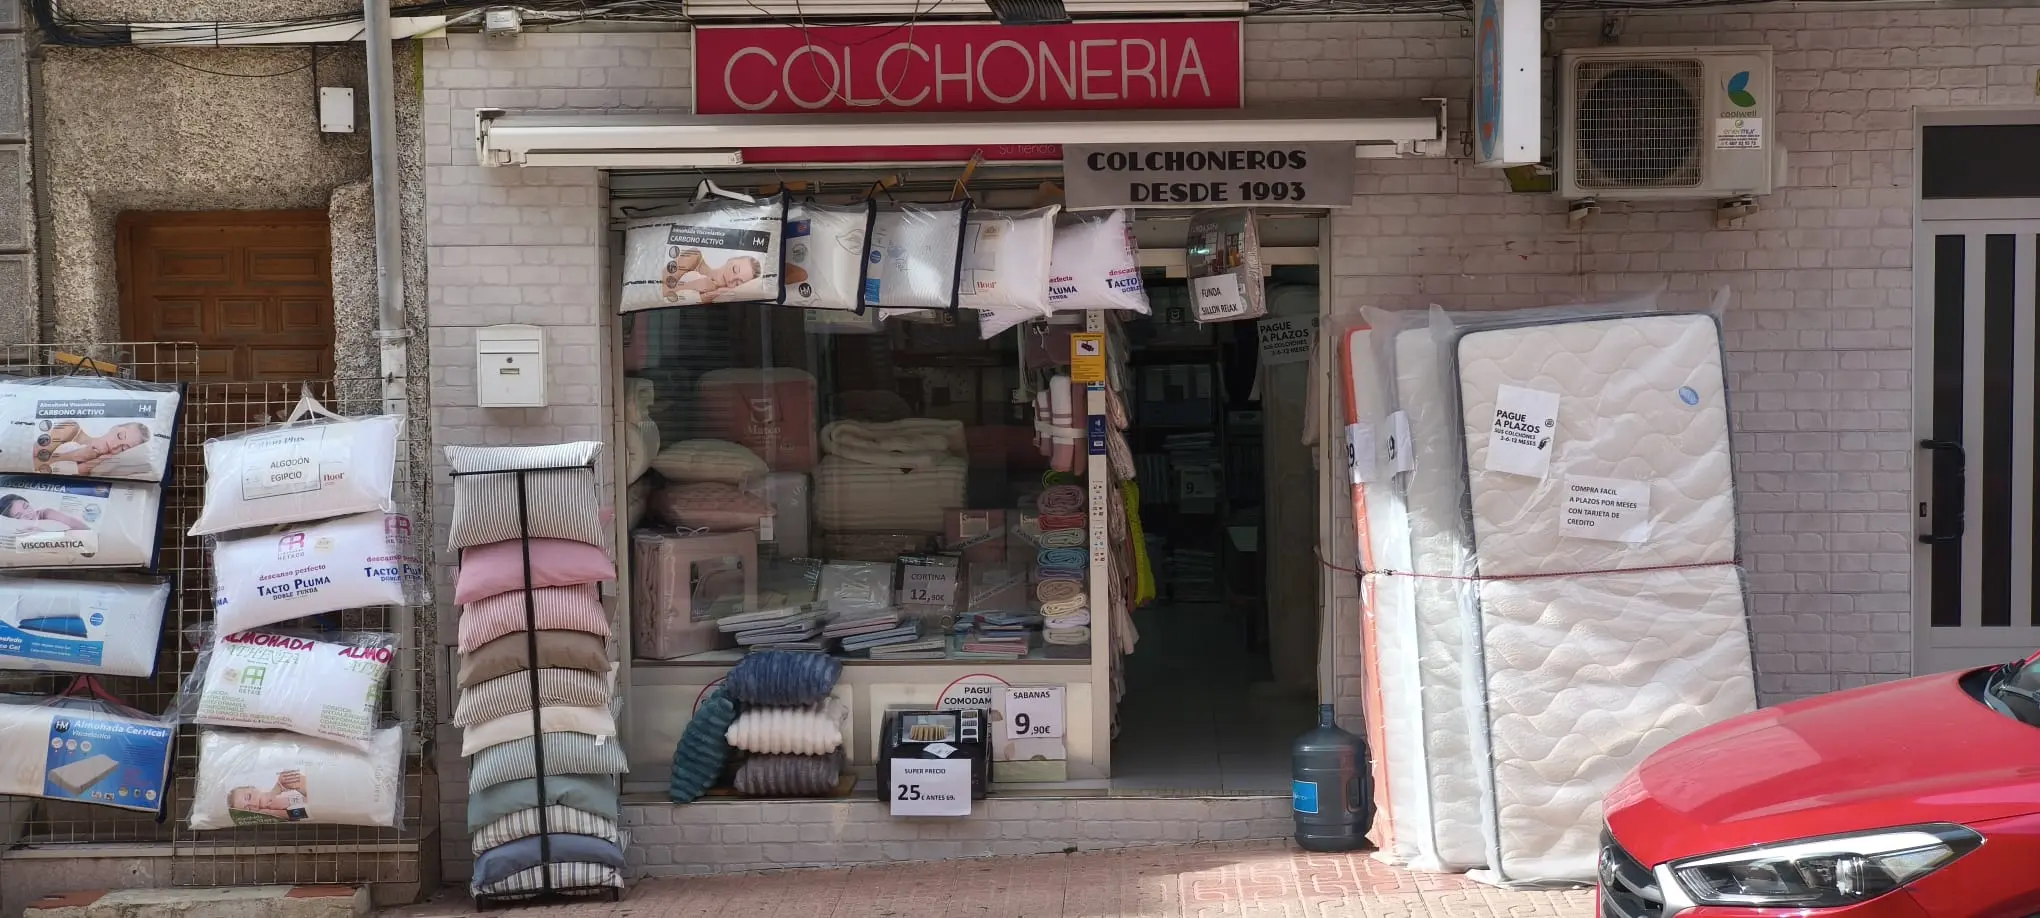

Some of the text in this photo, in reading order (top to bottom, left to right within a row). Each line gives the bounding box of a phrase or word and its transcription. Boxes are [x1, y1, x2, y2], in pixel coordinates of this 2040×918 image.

[723, 37, 1211, 110] COLCHONERIA
[1087, 150, 1307, 172] COLCHONEROS
[1129, 180, 1307, 203] DESDE 1993
[670, 235, 725, 246] CARBONO ACTIVO
[752, 236, 765, 247] HM
[1105, 278, 1138, 288] TACTO
[1201, 287, 1222, 298] FUNDA
[1201, 303, 1238, 315] SILLON RELAX
[1260, 321, 1292, 334] PAGUE
[1262, 329, 1310, 343] A PLAZOS
[138, 404, 152, 413] HM
[1496, 409, 1527, 422] PAGUE
[1494, 418, 1541, 434] A PLAZOS
[1504, 430, 1536, 440] COLCHONES
[1518, 438, 1536, 447] MESES
[270, 471, 302, 482] EGIPCIO
[1571, 485, 1599, 493] COMPRA
[1575, 497, 1600, 505] PLAZOS
[1584, 509, 1610, 517] TARJETA
[1567, 518, 1595, 526] CREDITO
[21, 540, 84, 549] VISCOELASTICA
[259, 564, 326, 581] descanso perfecto
[364, 566, 398, 578] TACTO
[911, 573, 946, 581] CORTINA
[257, 576, 331, 597] TACTO PLUMA
[273, 587, 318, 600] DOBLE FUNDA
[221, 631, 315, 652] ALMOHADA
[964, 686, 992, 694] PAGU
[1013, 690, 1051, 699] SABANAS
[56, 720, 69, 730] HM
[74, 720, 166, 738] Almohada Cervical
